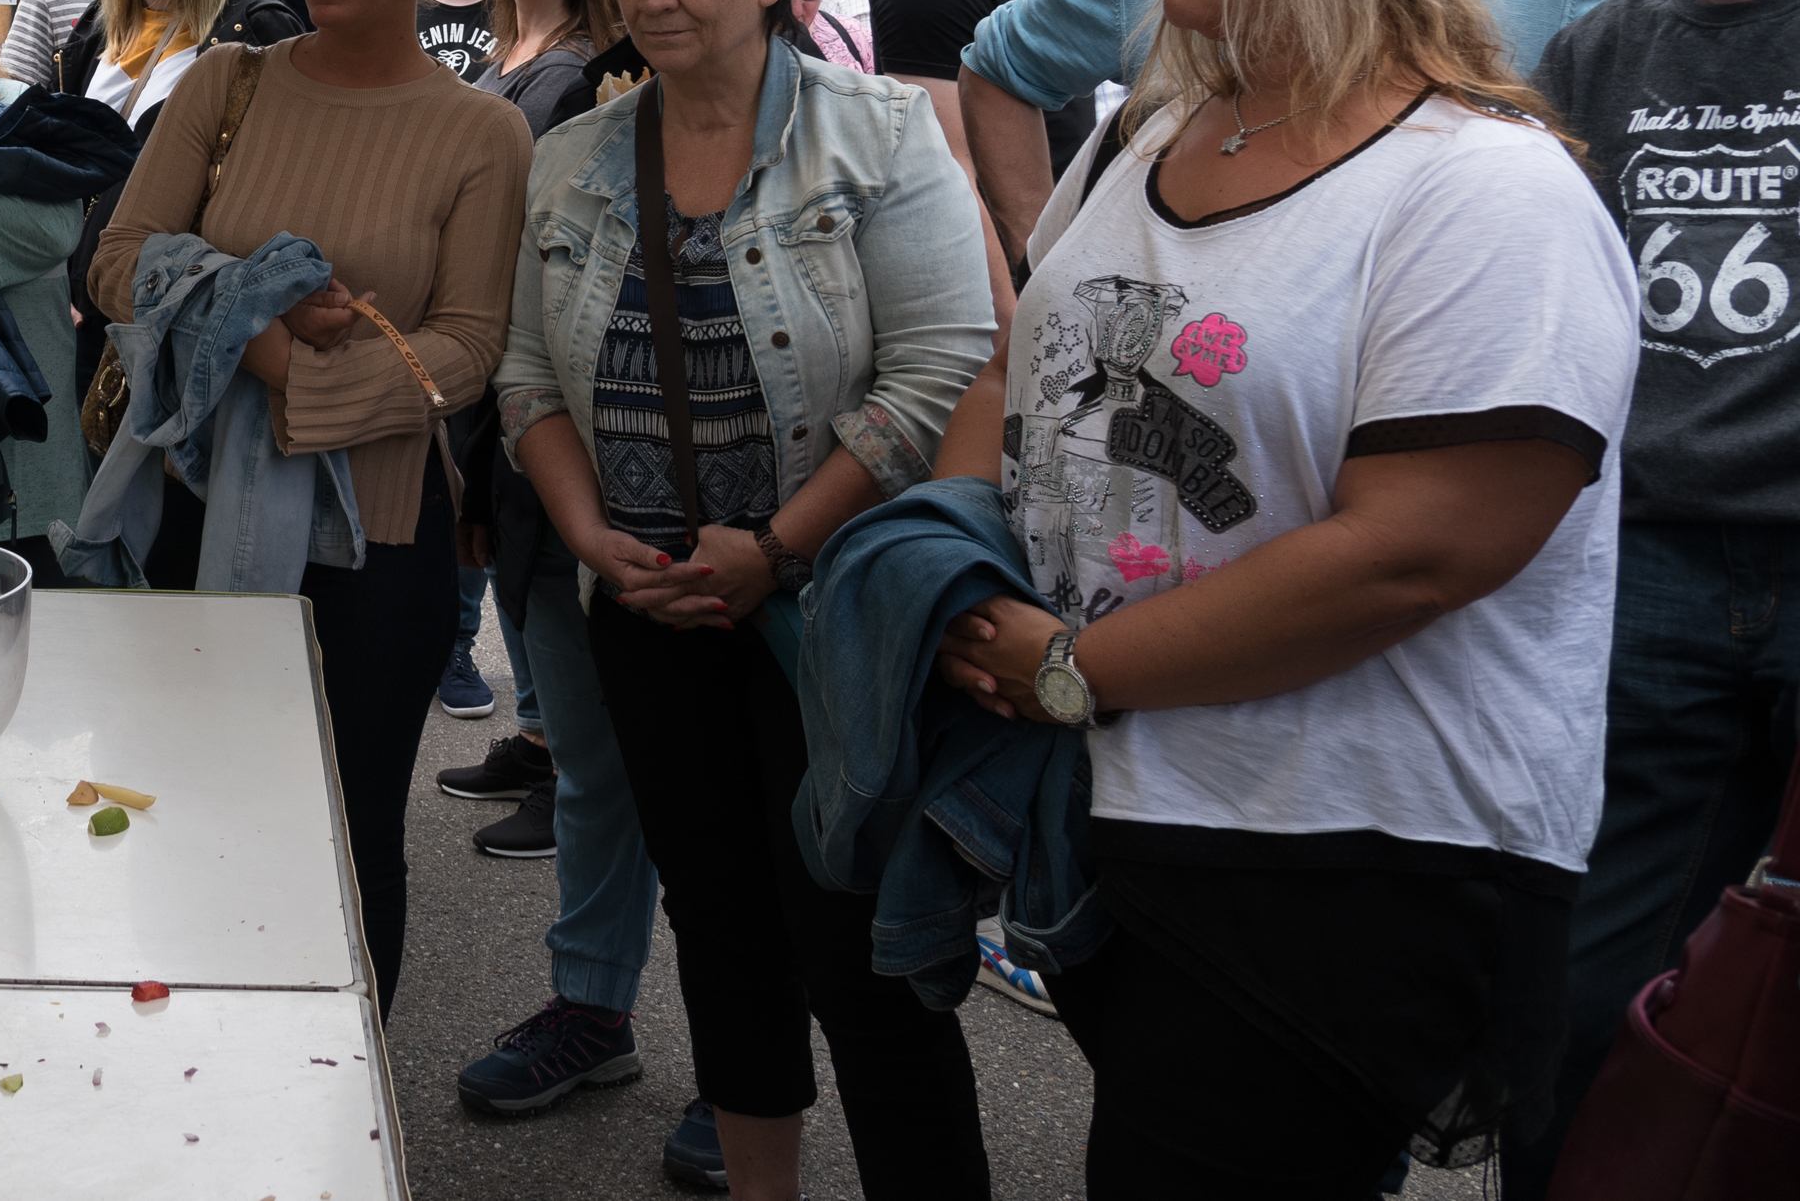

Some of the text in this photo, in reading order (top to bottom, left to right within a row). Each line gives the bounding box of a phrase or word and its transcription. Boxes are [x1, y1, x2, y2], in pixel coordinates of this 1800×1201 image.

[1626, 104, 1692, 134] That's
[1695, 104, 1739, 131] The
[1639, 220, 1790, 334] 66
[381, 324, 430, 382] ICED OUT
[1185, 427, 1218, 458] SO
